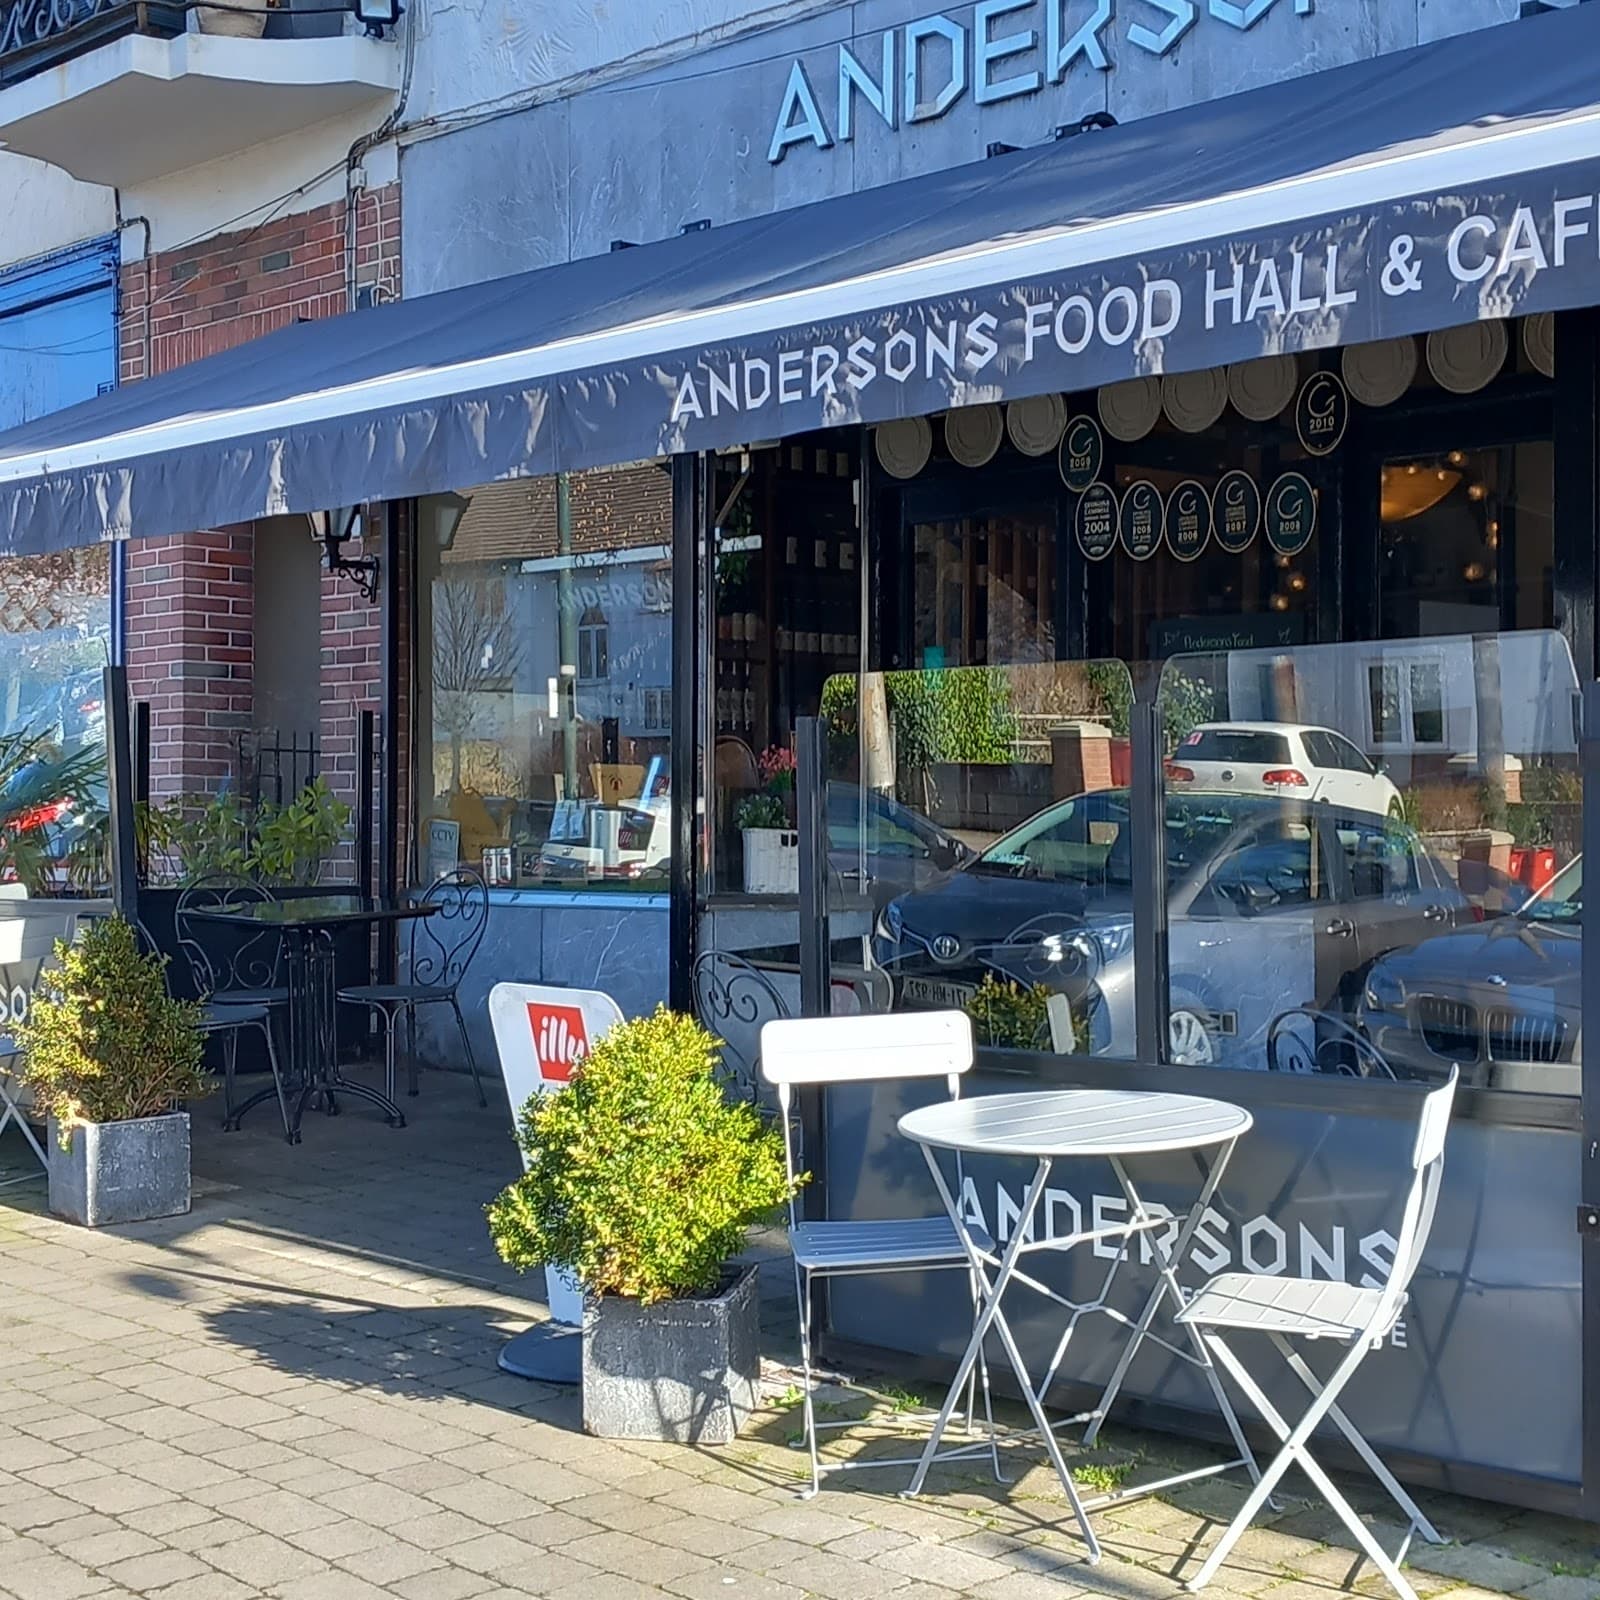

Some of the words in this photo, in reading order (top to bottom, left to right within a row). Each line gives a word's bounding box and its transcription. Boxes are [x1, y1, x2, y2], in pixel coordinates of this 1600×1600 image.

[671, 311, 999, 422] ANDERSONS
[1025, 279, 1181, 362] FOOD
[1205, 245, 1357, 330] HALL
[1381, 234, 1422, 296] &
[1447, 194, 1600, 282] CAF
[1309, 416, 1334, 430] 2010
[1085, 521, 1110, 535] 2004
[431, 829, 456, 841] CCTV
[956, 1176, 1399, 1291] ANDERSONS
